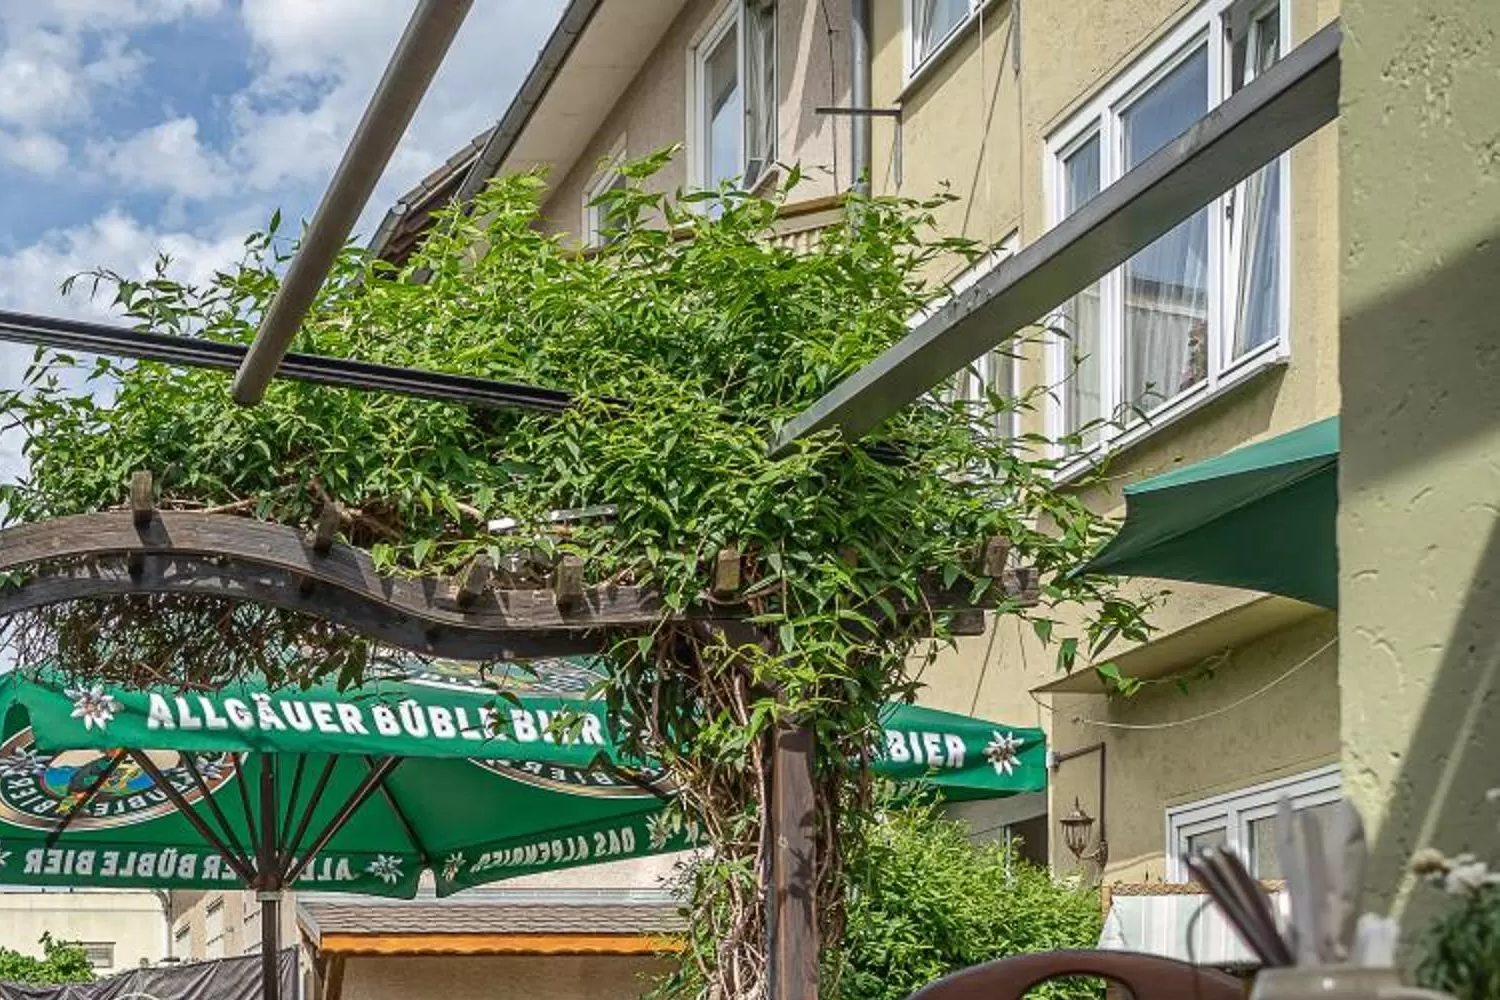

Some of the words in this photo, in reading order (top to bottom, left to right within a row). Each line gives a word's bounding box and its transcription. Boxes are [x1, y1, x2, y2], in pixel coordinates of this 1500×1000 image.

[147, 692, 369, 735] ALLGÄUER
[372, 699, 508, 740] BÜBLE
[872, 729, 967, 769] BIER
